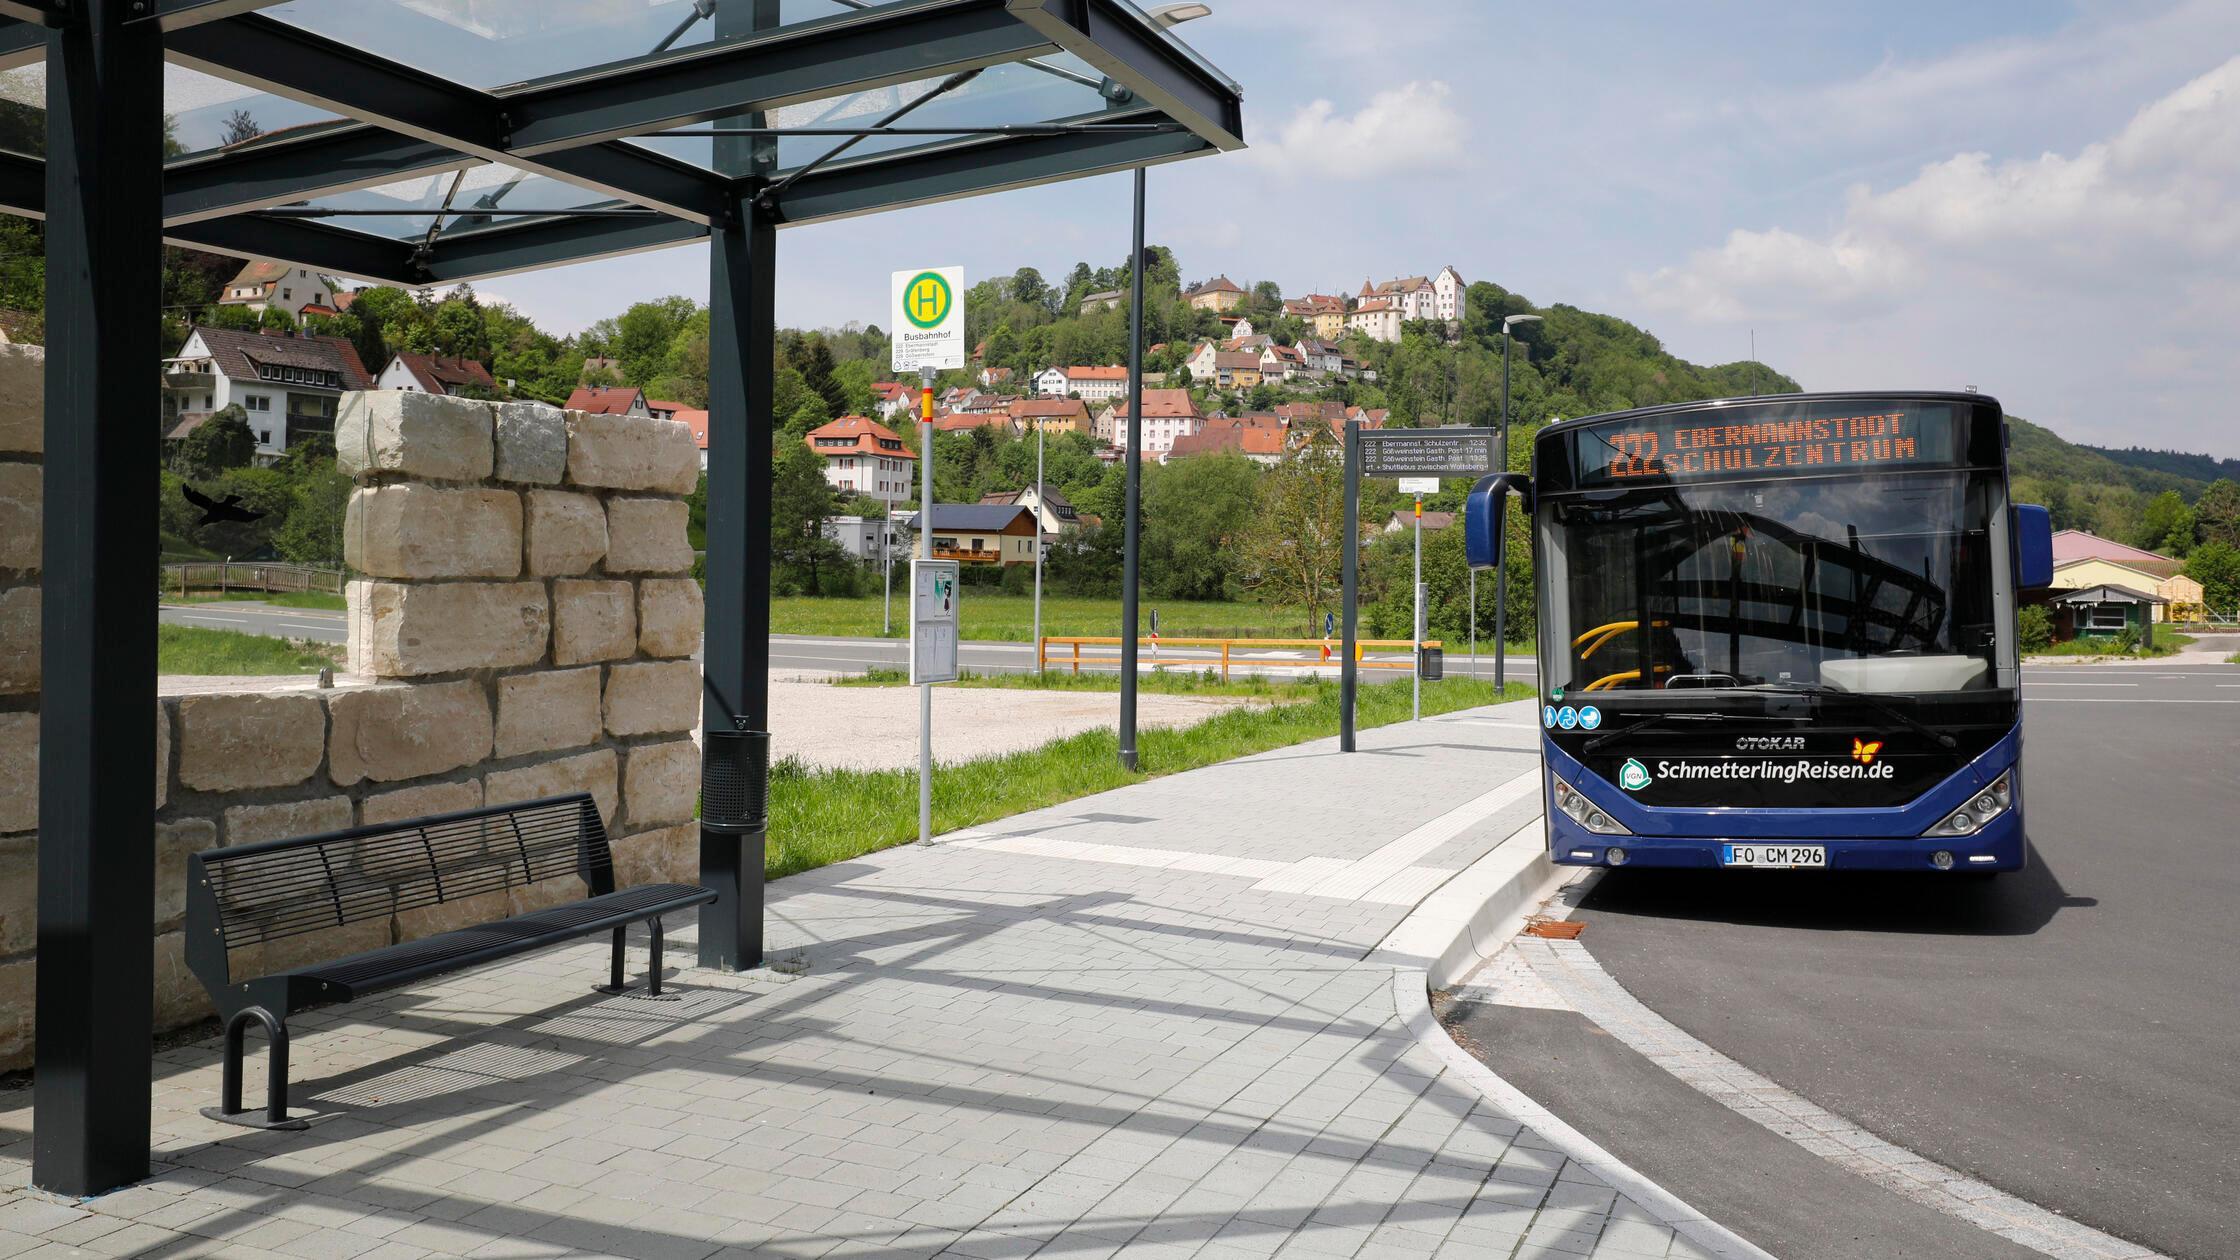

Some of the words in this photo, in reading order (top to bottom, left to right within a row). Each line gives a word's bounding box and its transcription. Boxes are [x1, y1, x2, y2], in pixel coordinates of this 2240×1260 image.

[918, 284, 937, 317] H
[904, 331, 951, 341] Busbahnhof
[1609, 431, 1658, 477] 222
[1674, 413, 1905, 450] EBERMANNSTADT
[1663, 437, 1915, 473] SCHULZENTRUM
[1736, 736, 1805, 750] OTOKAR
[1626, 772, 1642, 781] VGN
[1657, 760, 1894, 783] SchmetterlingReisen.de
[1733, 848, 1755, 863] FO
[1766, 848, 1788, 863] CM
[1791, 848, 1823, 863] 296
